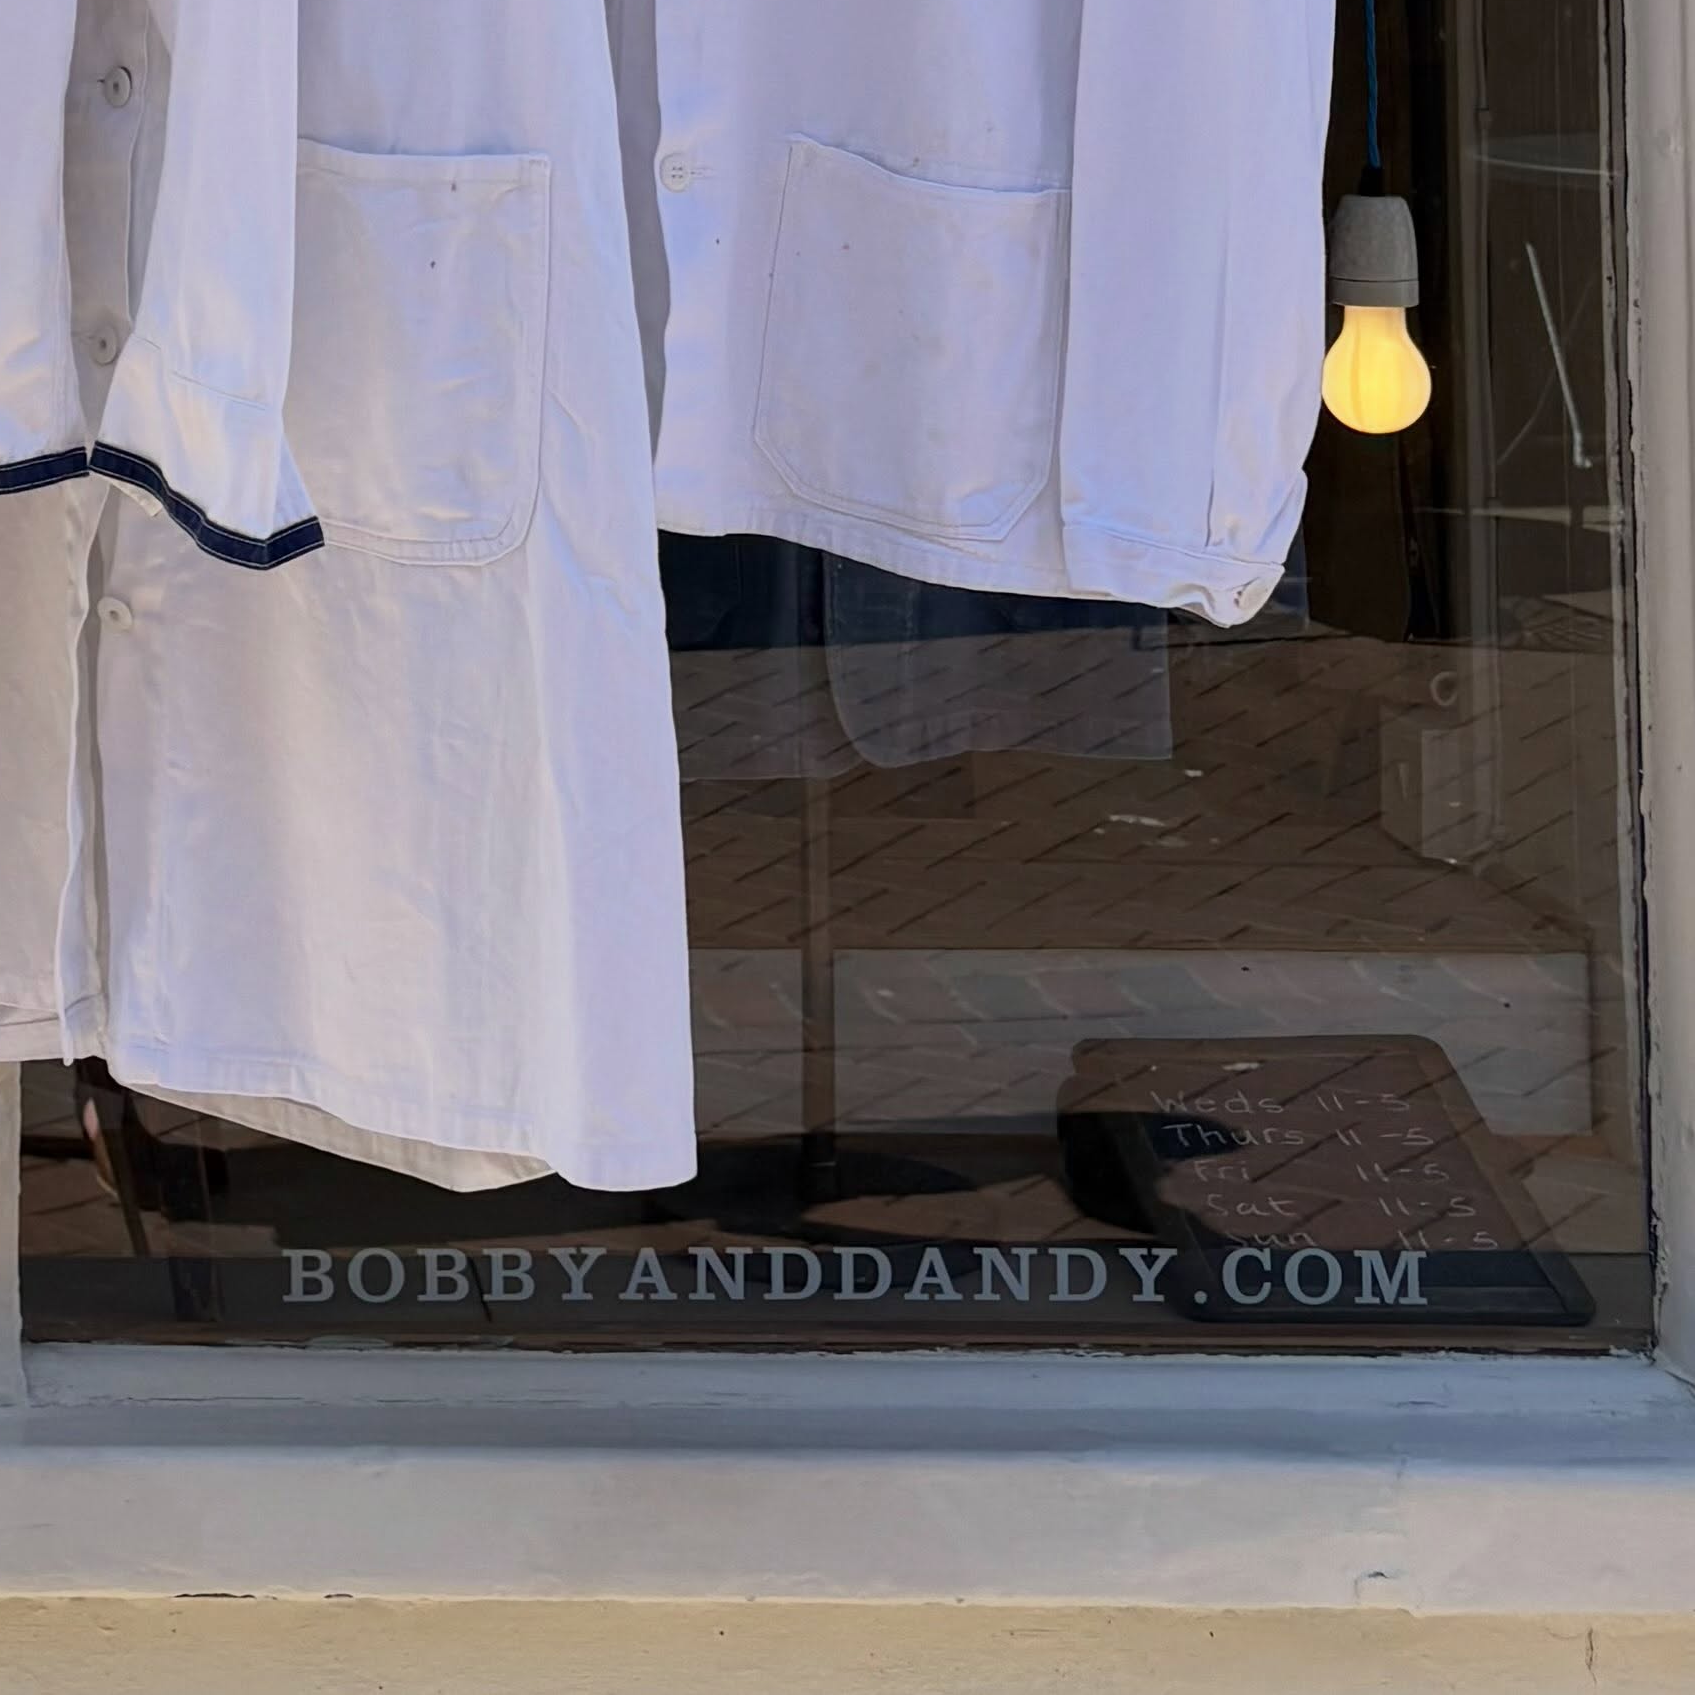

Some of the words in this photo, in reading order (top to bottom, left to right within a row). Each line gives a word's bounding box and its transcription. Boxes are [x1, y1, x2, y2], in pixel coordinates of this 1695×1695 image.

[1151, 1089, 1285, 1114] Weds
[1161, 1123, 1304, 1147] Thurs
[1193, 1159, 1250, 1183] Fri
[1206, 1193, 1298, 1217] Sat
[1225, 1230, 1317, 1251] Sun
[281, 1245, 1429, 1307] BOBBYANDDANDY.COM
